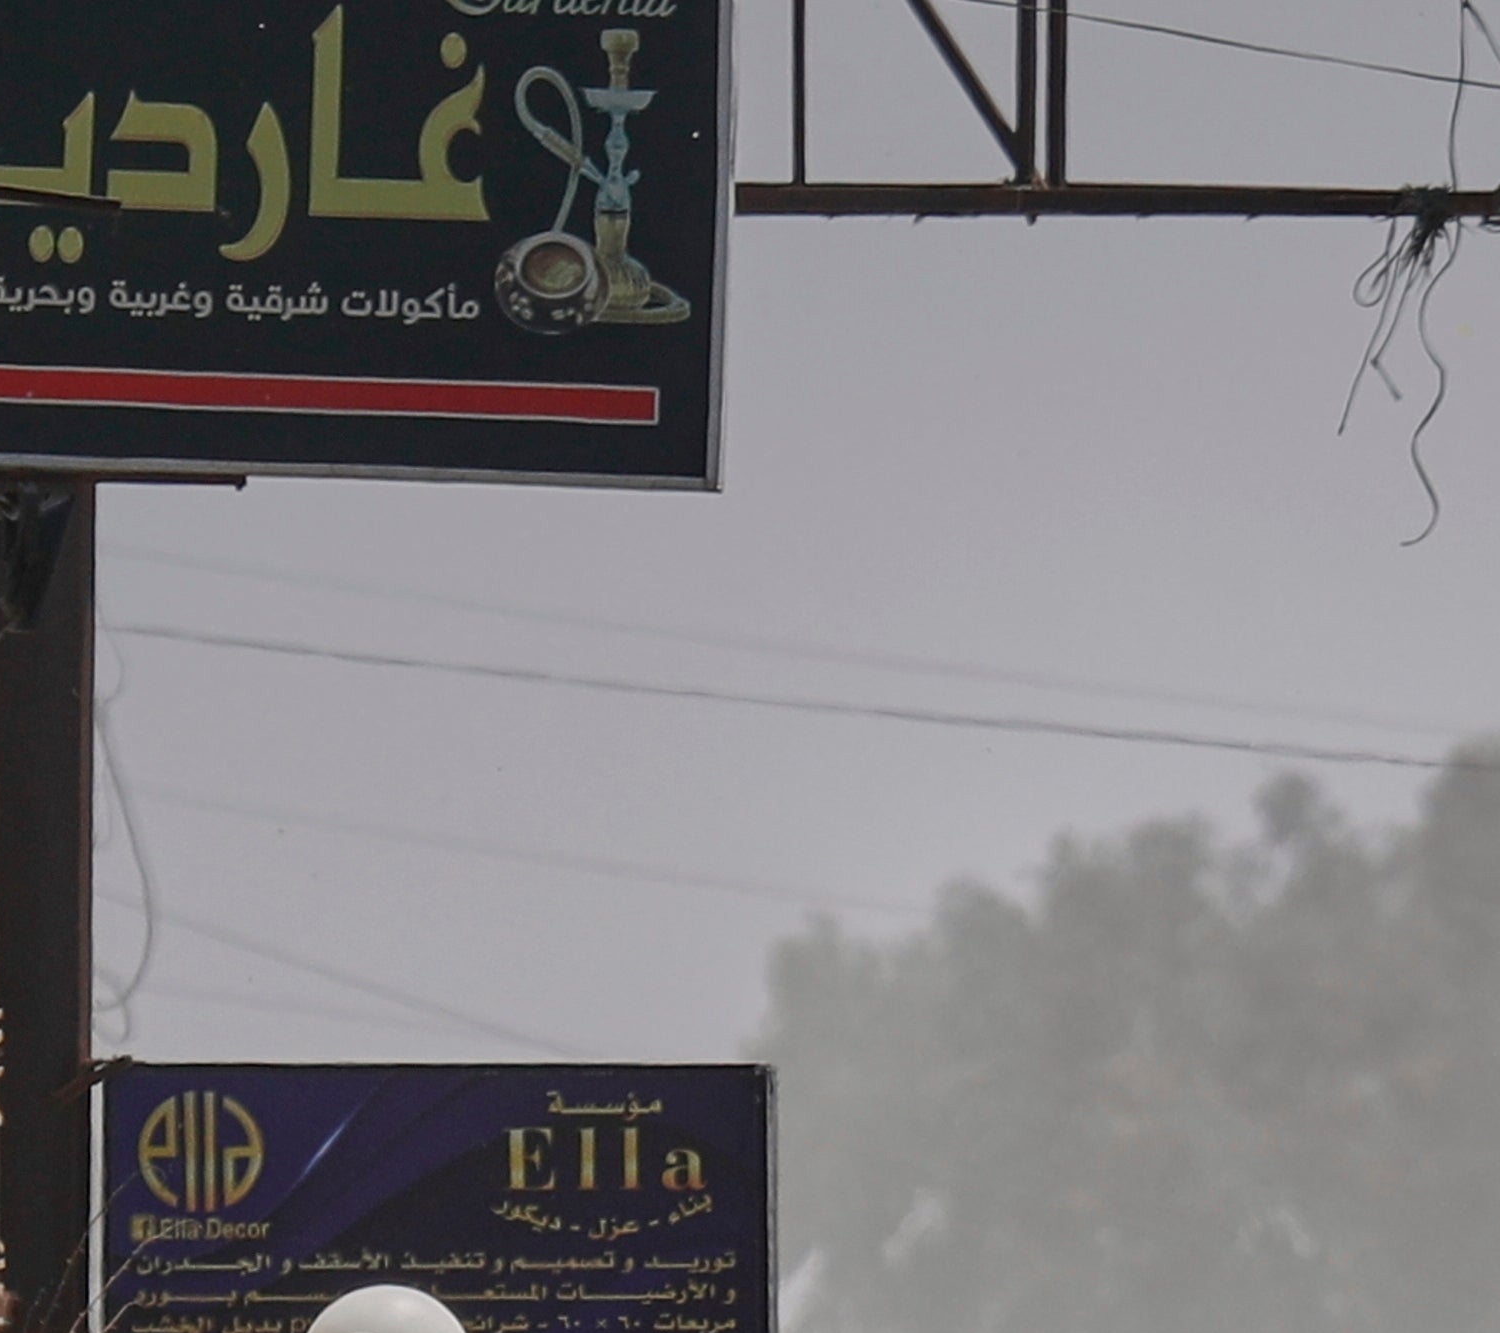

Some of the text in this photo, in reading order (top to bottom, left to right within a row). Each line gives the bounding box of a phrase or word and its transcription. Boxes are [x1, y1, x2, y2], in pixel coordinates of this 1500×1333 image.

[109, 279, 213, 318] وغربية
[226, 281, 329, 321] شرقية
[341, 283, 480, 325] مأكولات
[546, 1090, 663, 1121] مؤسسة
[502, 1126, 707, 1191] Ella
[489, 1200, 563, 1233] ديكور
[667, 1193, 714, 1226] بناء
[206, 1217, 271, 1239] Decor
[586, 1216, 641, 1241] عزل
[136, 1253, 271, 1276] الجدران
[299, 1248, 390, 1273] الأسقف
[400, 1251, 485, 1274] تنفيذ
[510, 1250, 616, 1274] تصميم
[643, 1251, 737, 1274] توريد
[555, 1280, 716, 1305] الأرضيات
